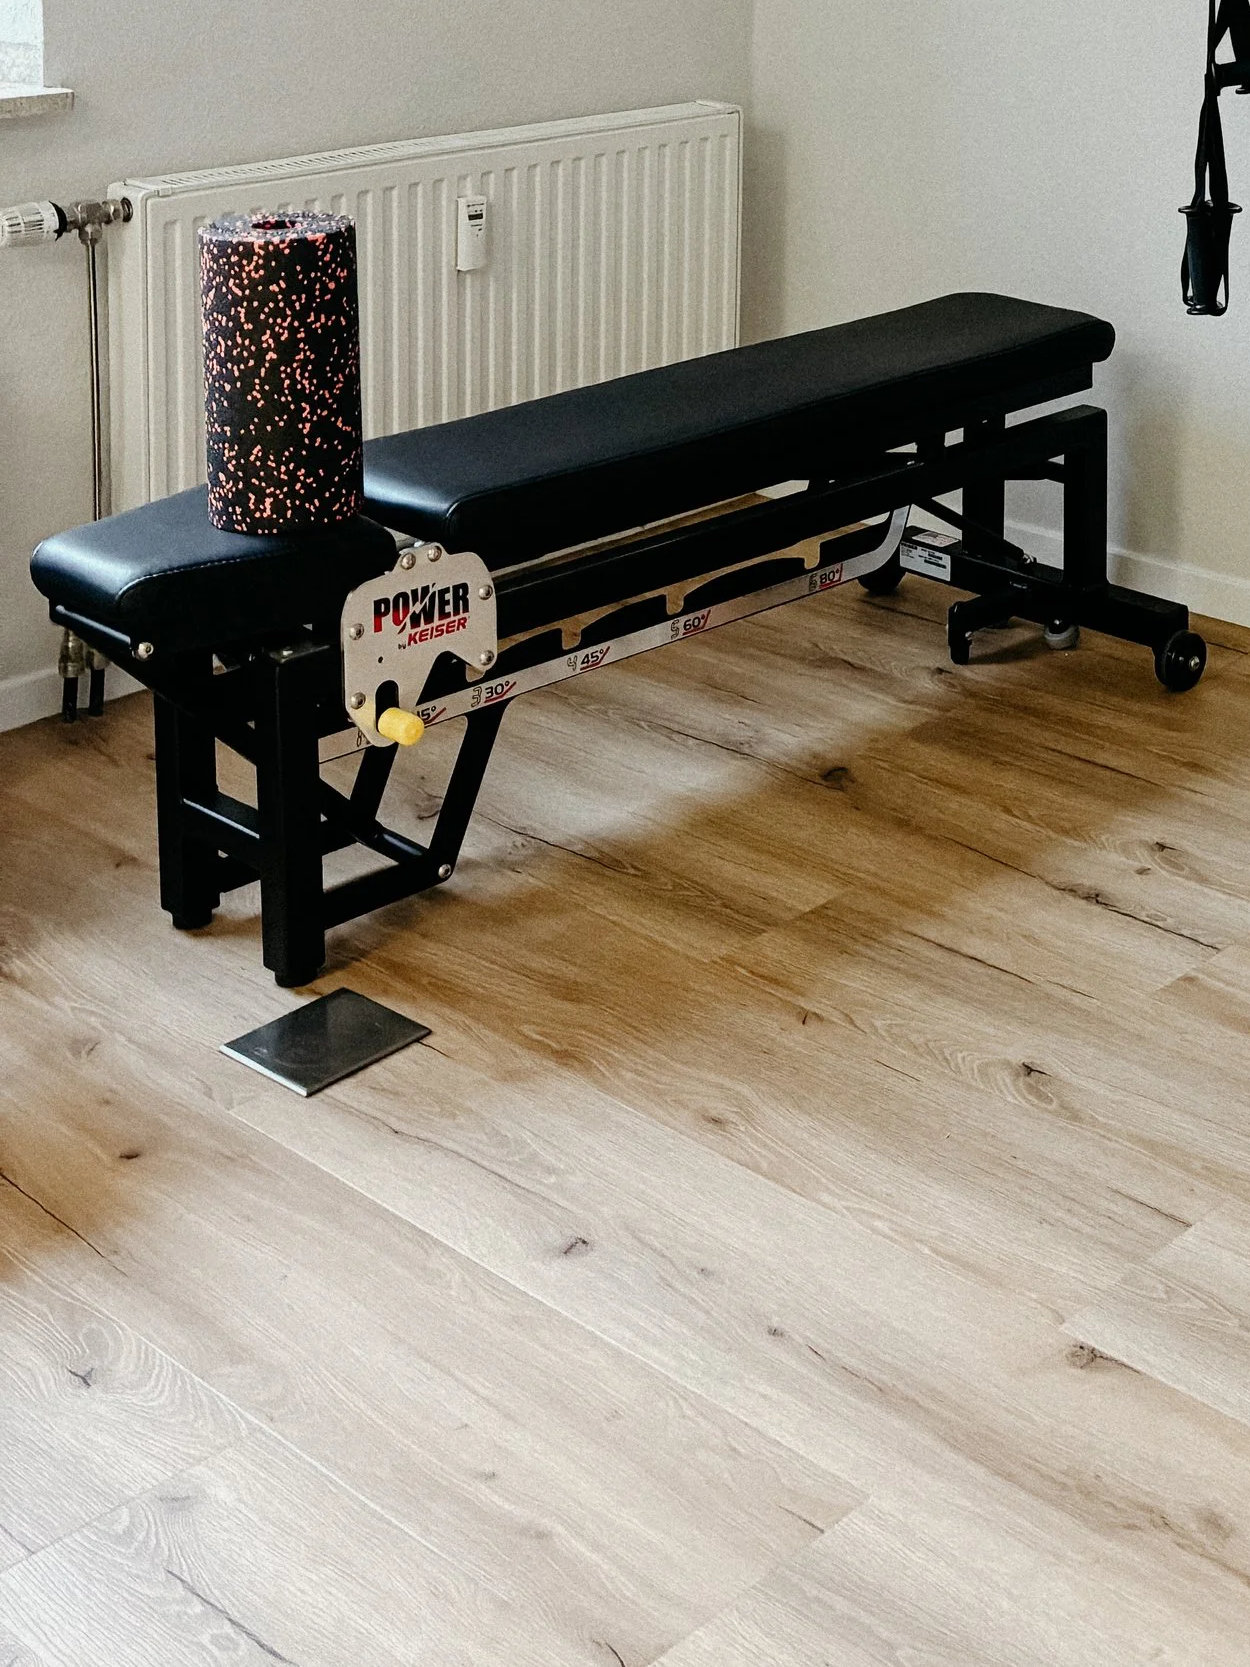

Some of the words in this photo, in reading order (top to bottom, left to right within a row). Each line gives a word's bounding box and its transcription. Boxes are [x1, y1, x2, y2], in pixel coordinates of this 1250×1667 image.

[373, 582, 470, 635] POWER
[407, 617, 468, 647] KEISER
[580, 648, 604, 666] 45°
[470, 686, 482, 708] 3
[485, 680, 510, 699] 30°
